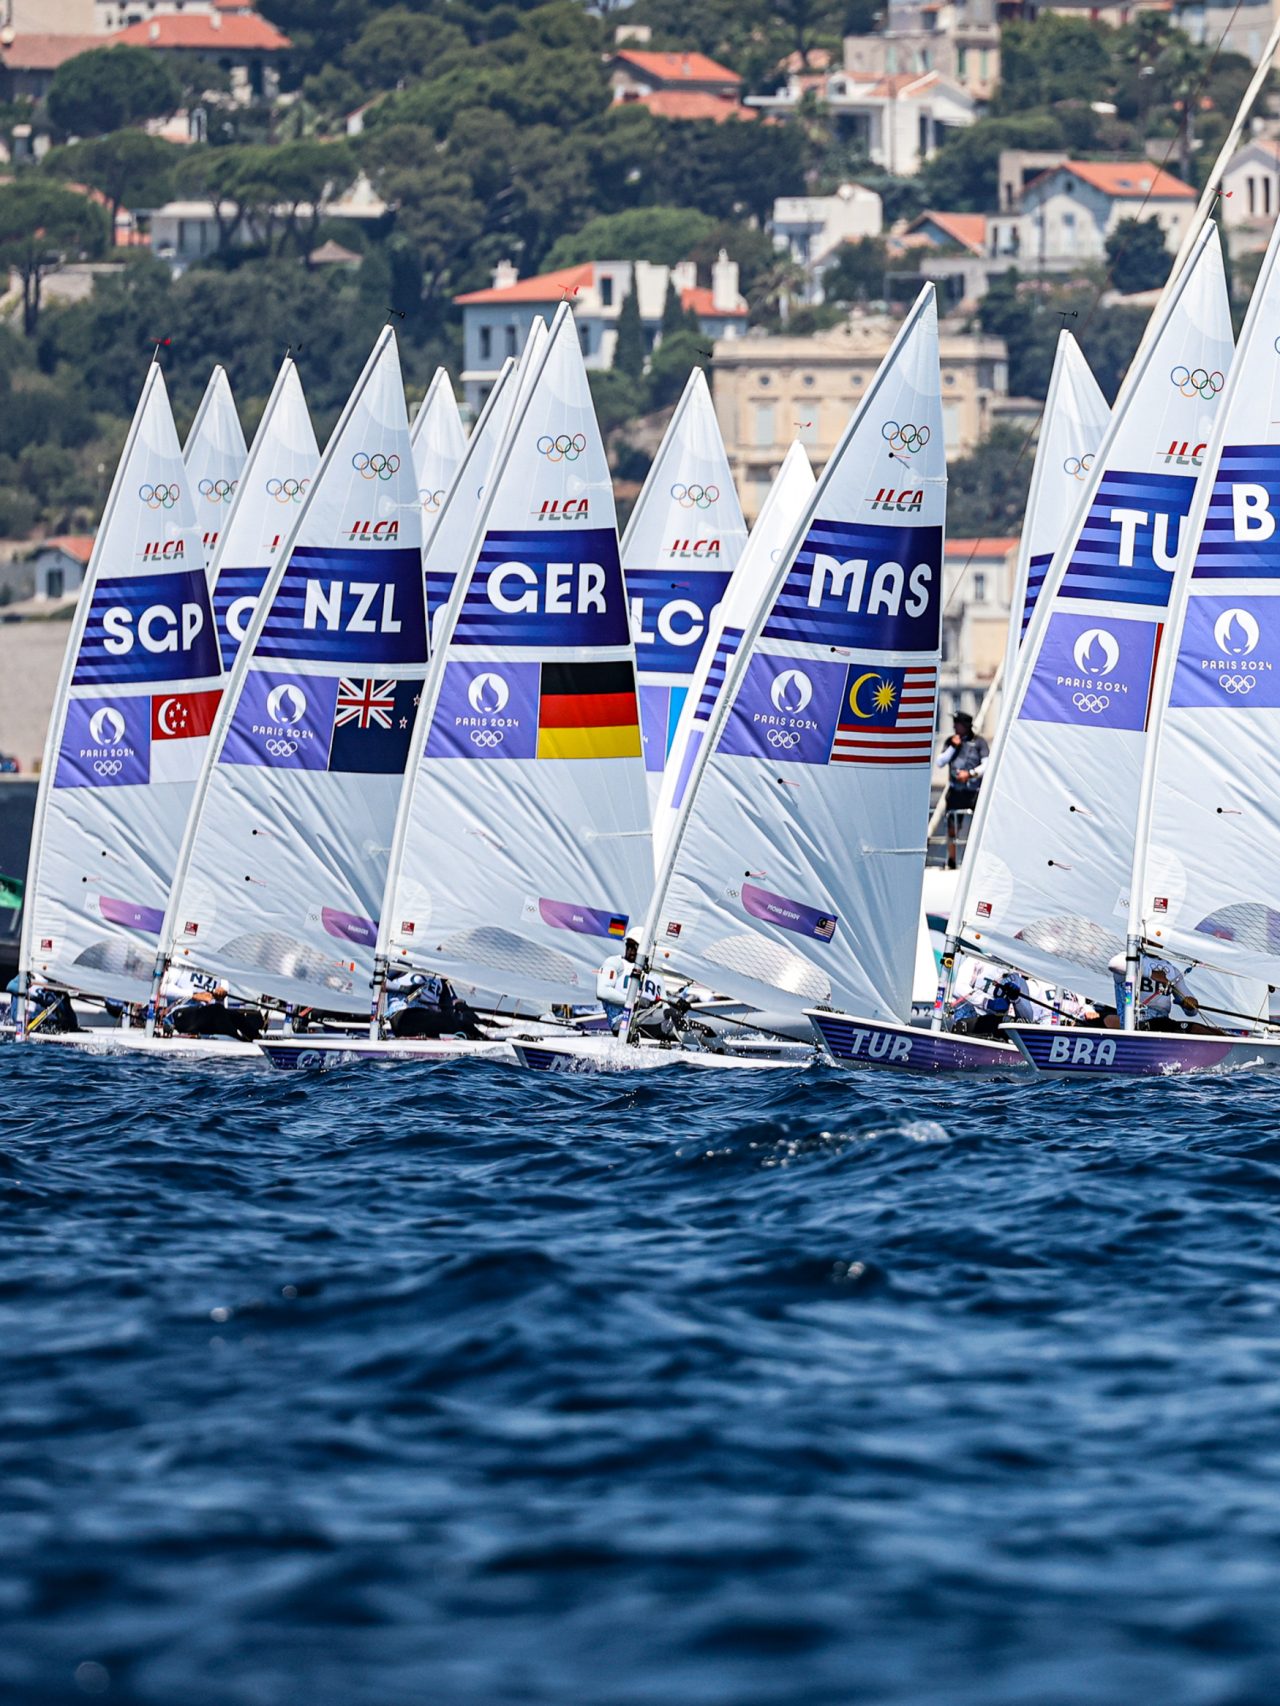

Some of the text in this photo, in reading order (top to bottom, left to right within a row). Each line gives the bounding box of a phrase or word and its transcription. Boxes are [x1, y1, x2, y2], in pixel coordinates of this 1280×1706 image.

[1165, 441, 1207, 466] ILC
[538, 499, 588, 521] ILCA
[871, 488, 923, 512] ILCA
[349, 521, 399, 541] ILCA
[1110, 509, 1189, 572] TU
[143, 540, 184, 562] ILCA
[670, 539, 720, 558] ILCA
[486, 561, 607, 614] GER
[807, 553, 932, 618] MAS
[303, 579, 402, 633] NZL
[103, 602, 204, 655] SGP
[1201, 659, 1272, 671] PARIS 2024
[1057, 676, 1128, 694] PARIS 2024
[252, 725, 313, 739] PARIS 2024
[455, 717, 519, 727] PARIS 2024
[754, 713, 818, 730] PARIS 2024
[80, 748, 134, 758] PARIS 2024
[851, 1028, 913, 1061] TUR
[1048, 1036, 1117, 1065] BRA
